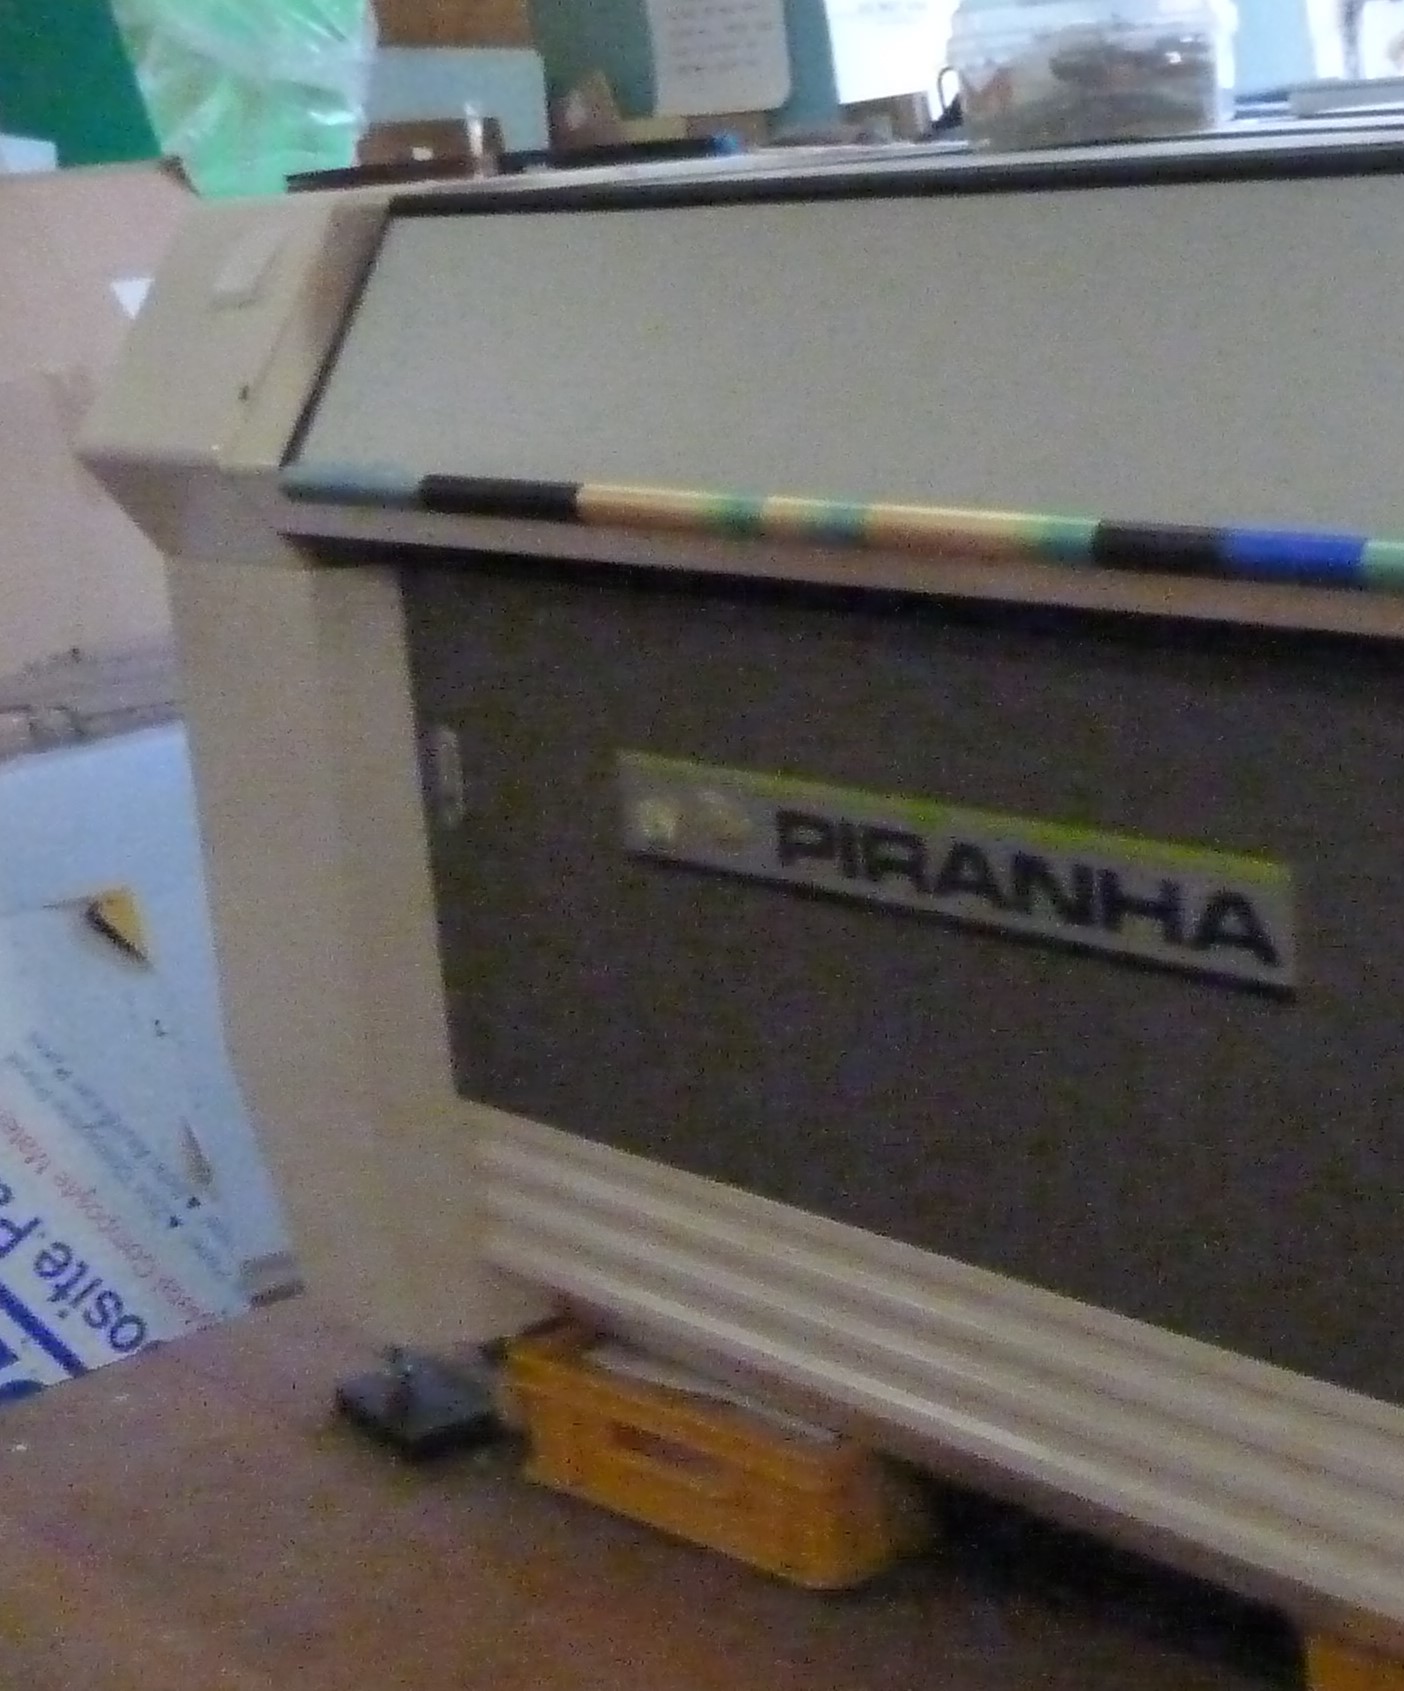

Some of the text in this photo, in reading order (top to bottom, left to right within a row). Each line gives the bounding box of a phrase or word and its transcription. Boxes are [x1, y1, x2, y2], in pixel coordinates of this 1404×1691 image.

[775, 808, 1281, 968] PIRANHA
[53, 1170, 157, 1279] Composite
[34, 1241, 147, 1352] osite
